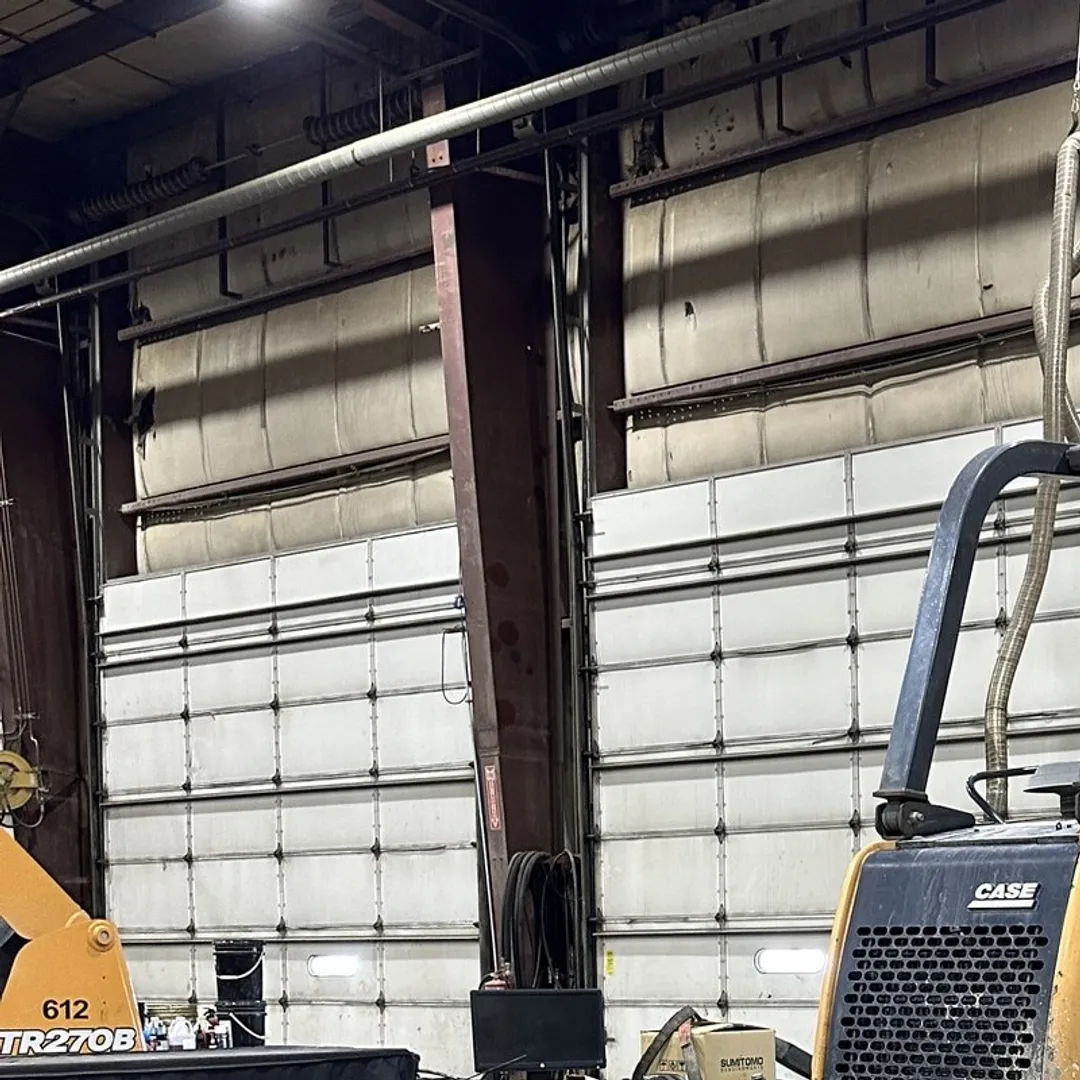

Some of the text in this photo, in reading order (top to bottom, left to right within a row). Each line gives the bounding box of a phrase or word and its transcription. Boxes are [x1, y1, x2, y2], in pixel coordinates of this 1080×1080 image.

[974, 882, 1038, 900] CASE
[42, 999, 90, 1020] 612
[0, 1028, 136, 1054] TR270B
[720, 1056, 764, 1068] SUMITOMO
